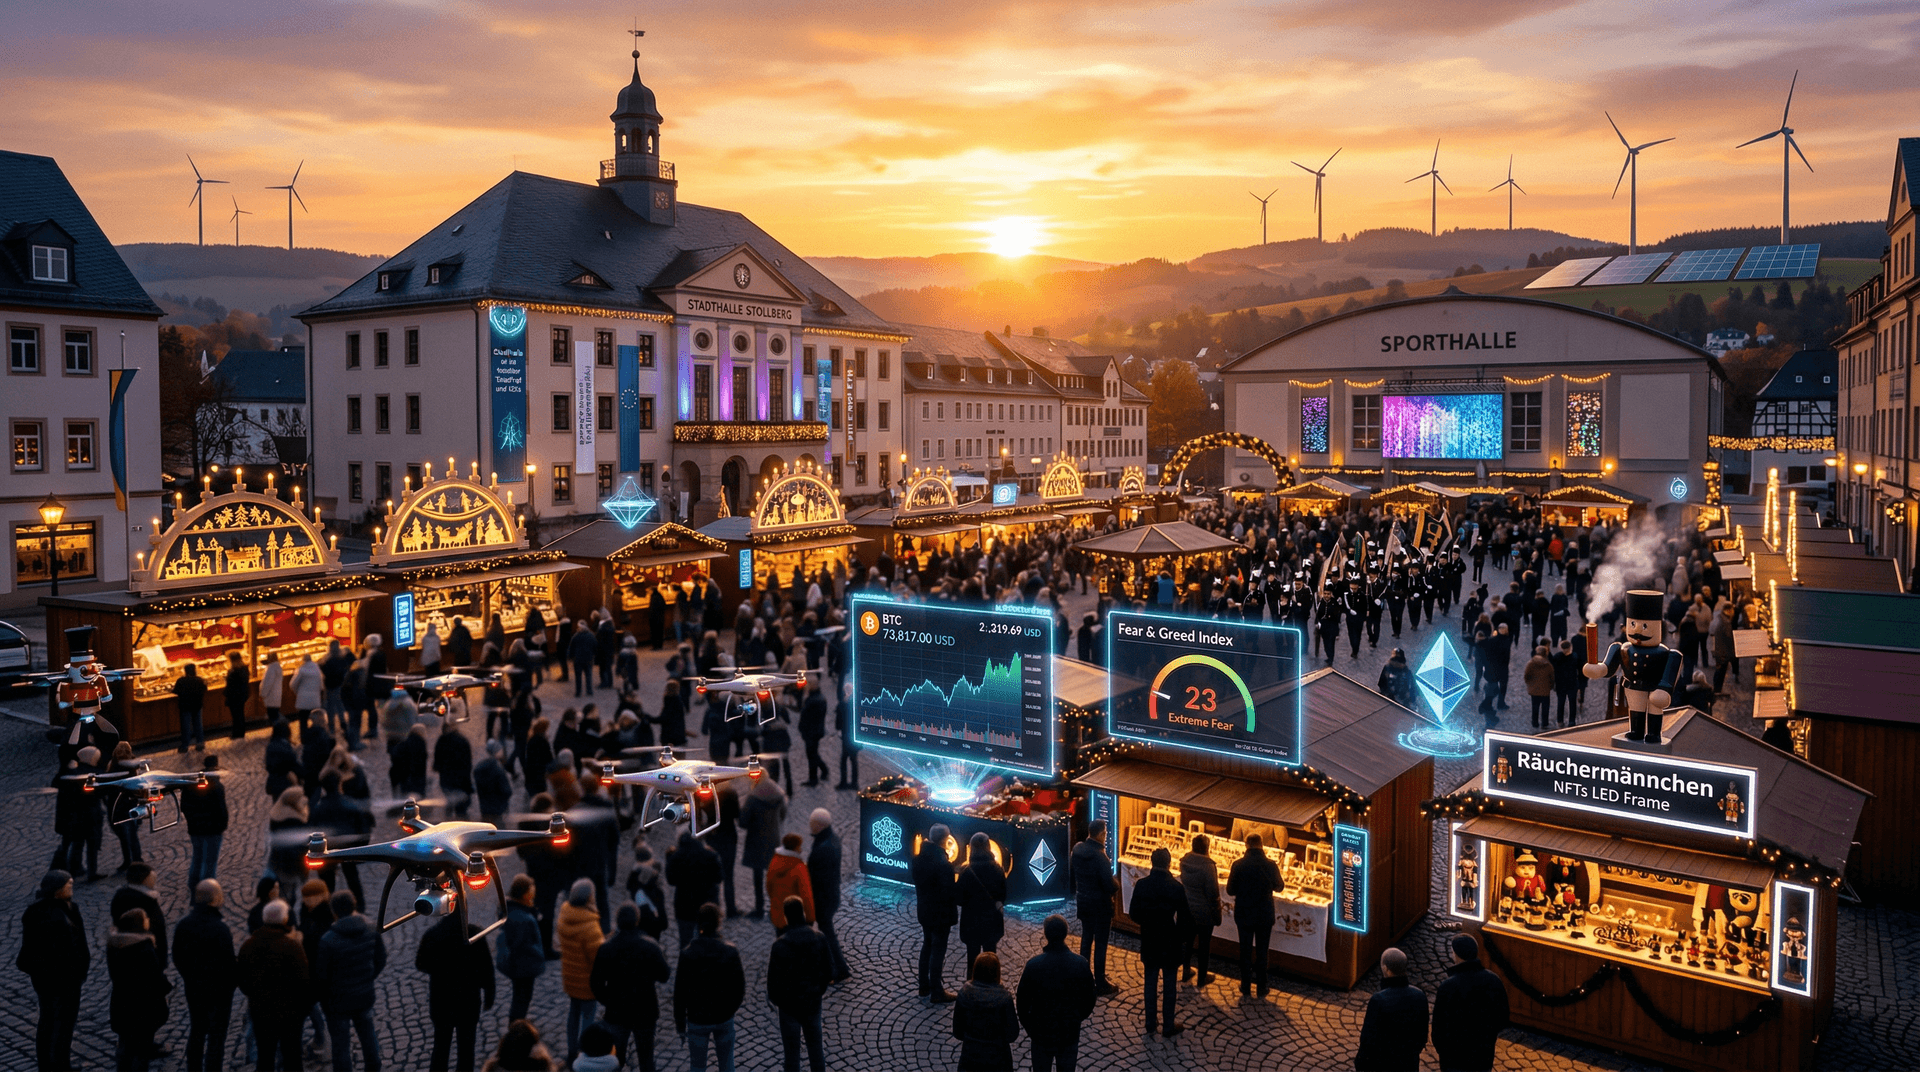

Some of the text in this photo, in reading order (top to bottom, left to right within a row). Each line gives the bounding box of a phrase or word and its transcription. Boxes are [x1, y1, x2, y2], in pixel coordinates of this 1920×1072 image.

[688, 299, 792, 320] STADTHALLE STOLLBERG
[1381, 331, 1517, 352] SPORTHALLE
[882, 614, 902, 626] BTC
[882, 629, 956, 647] 73,817.00 USD
[1023, 627, 1042, 638] USD
[1118, 623, 1234, 647] Fear & Greed Index
[1184, 686, 1217, 712] 23
[1168, 712, 1234, 731] Extreme Fear
[1517, 751, 1714, 798] Räuchermännchen
[1553, 780, 1670, 811] NFTs LED Frame
